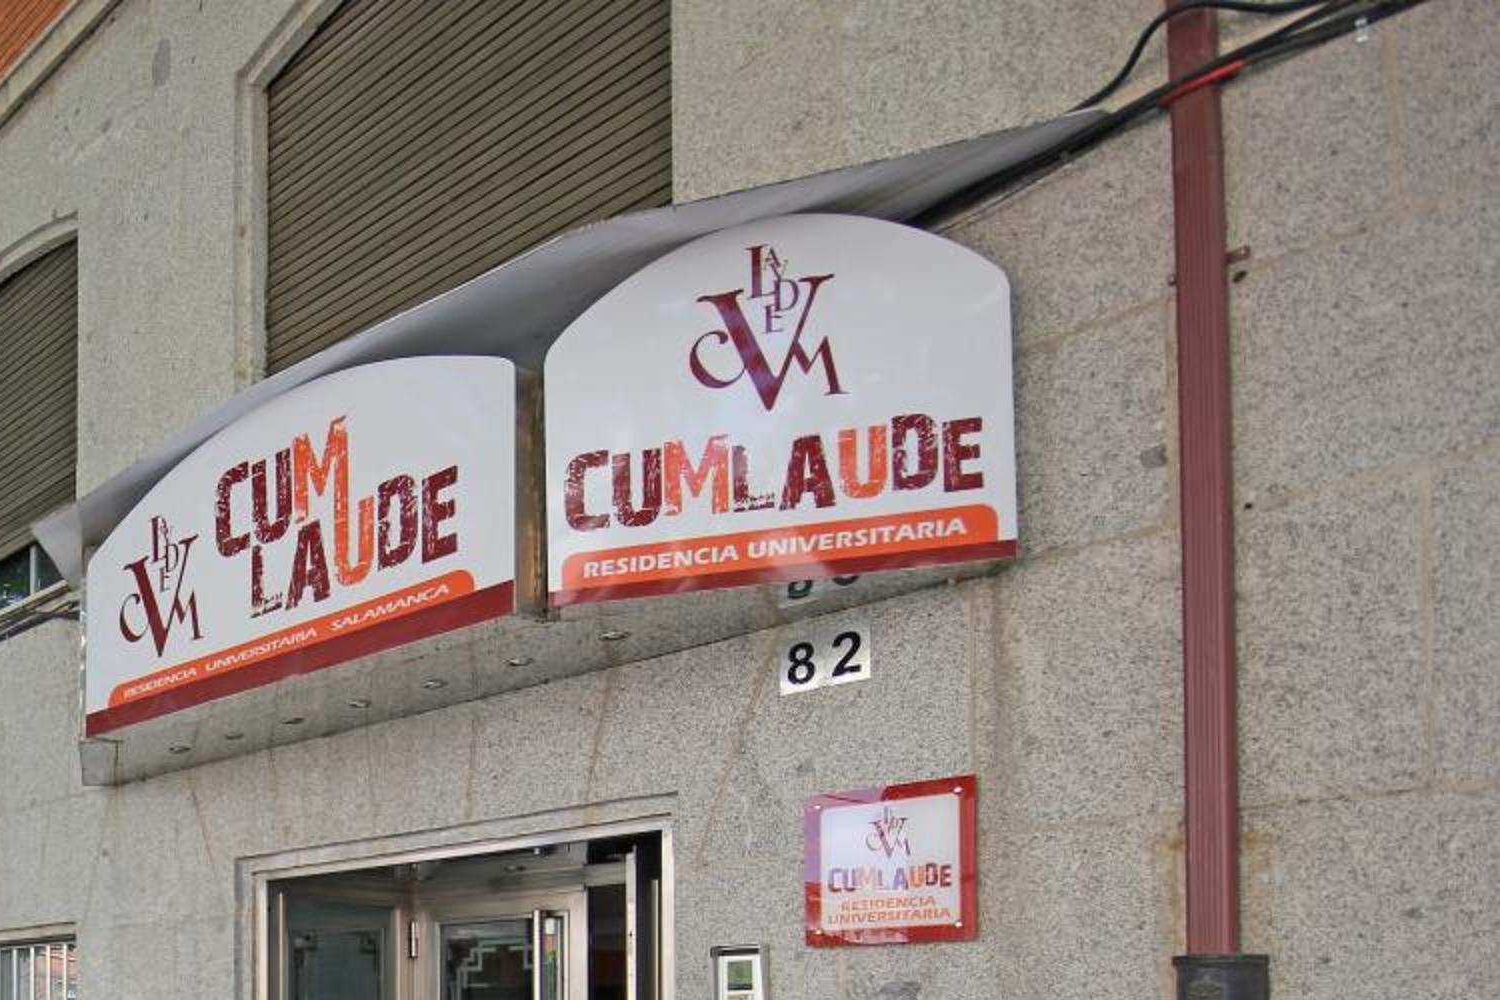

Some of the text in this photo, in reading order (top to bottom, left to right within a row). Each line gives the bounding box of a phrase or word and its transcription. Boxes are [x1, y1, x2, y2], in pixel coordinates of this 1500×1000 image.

[215, 414, 347, 558] CUM
[250, 465, 458, 619] LAUDE
[583, 517, 967, 578] RESIDENCIA UNIVERSITARIA
[123, 583, 451, 699] RESIDENCIA UNIVERSITARIA SALAMANCA
[787, 631, 862, 685] 82
[828, 908, 951, 925] UNIVERSITARIA
[841, 895, 936, 911] RESIDENCIA
